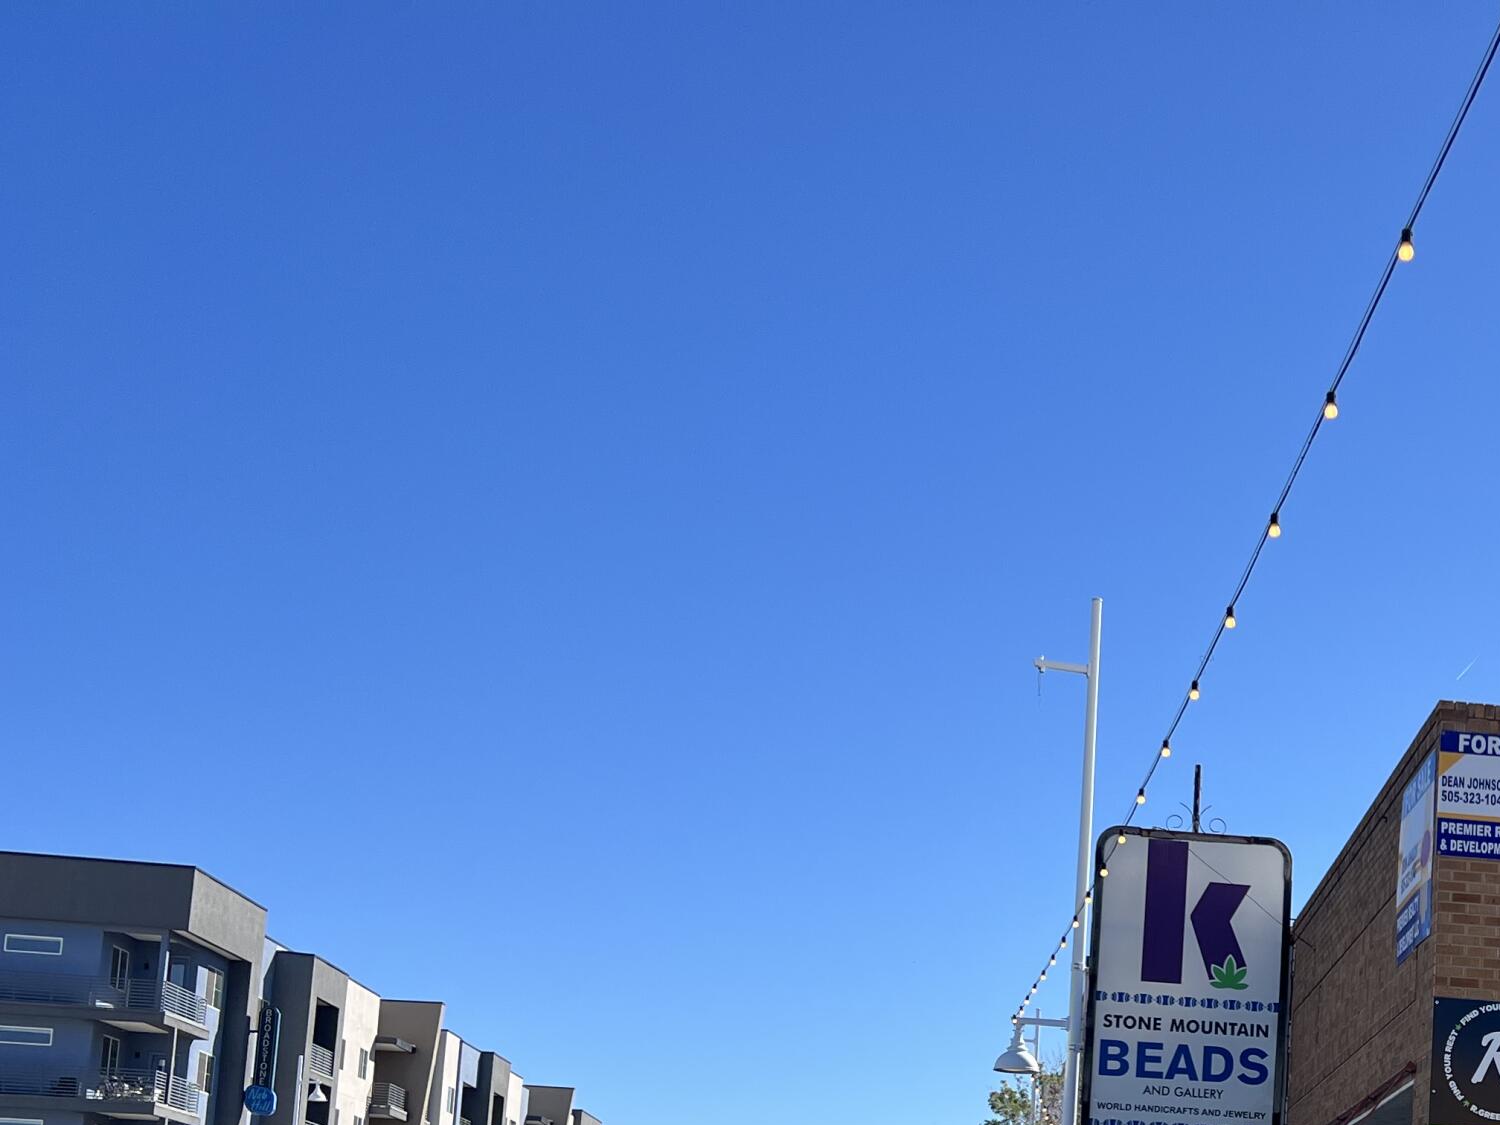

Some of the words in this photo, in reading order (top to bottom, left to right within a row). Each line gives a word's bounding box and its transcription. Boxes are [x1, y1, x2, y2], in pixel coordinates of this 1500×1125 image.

[1441, 775, 1465, 788] DEAN
[1440, 821, 1492, 837] PREMIER
[1440, 838, 1448, 851] &
[1103, 1014, 1162, 1031] STONE
[1170, 1019, 1269, 1038] MOUNTAIN
[1459, 1009, 1480, 1026] FIND
[258, 1008, 273, 1086] BROADSTONE
[1445, 1029, 1459, 1053] REST
[1098, 1039, 1269, 1086] BEADS
[1444, 1052, 1454, 1080] YOUR
[1142, 1085, 1171, 1097] AND
[1174, 1086, 1224, 1100] GALLERY
[1448, 1080, 1465, 1102] FIND
[1097, 1101, 1132, 1111] WORLD
[1134, 1104, 1199, 1116] HANDICRAFTS
[1201, 1108, 1221, 1117] AND
[1223, 1110, 1266, 1120] JEWELRY
